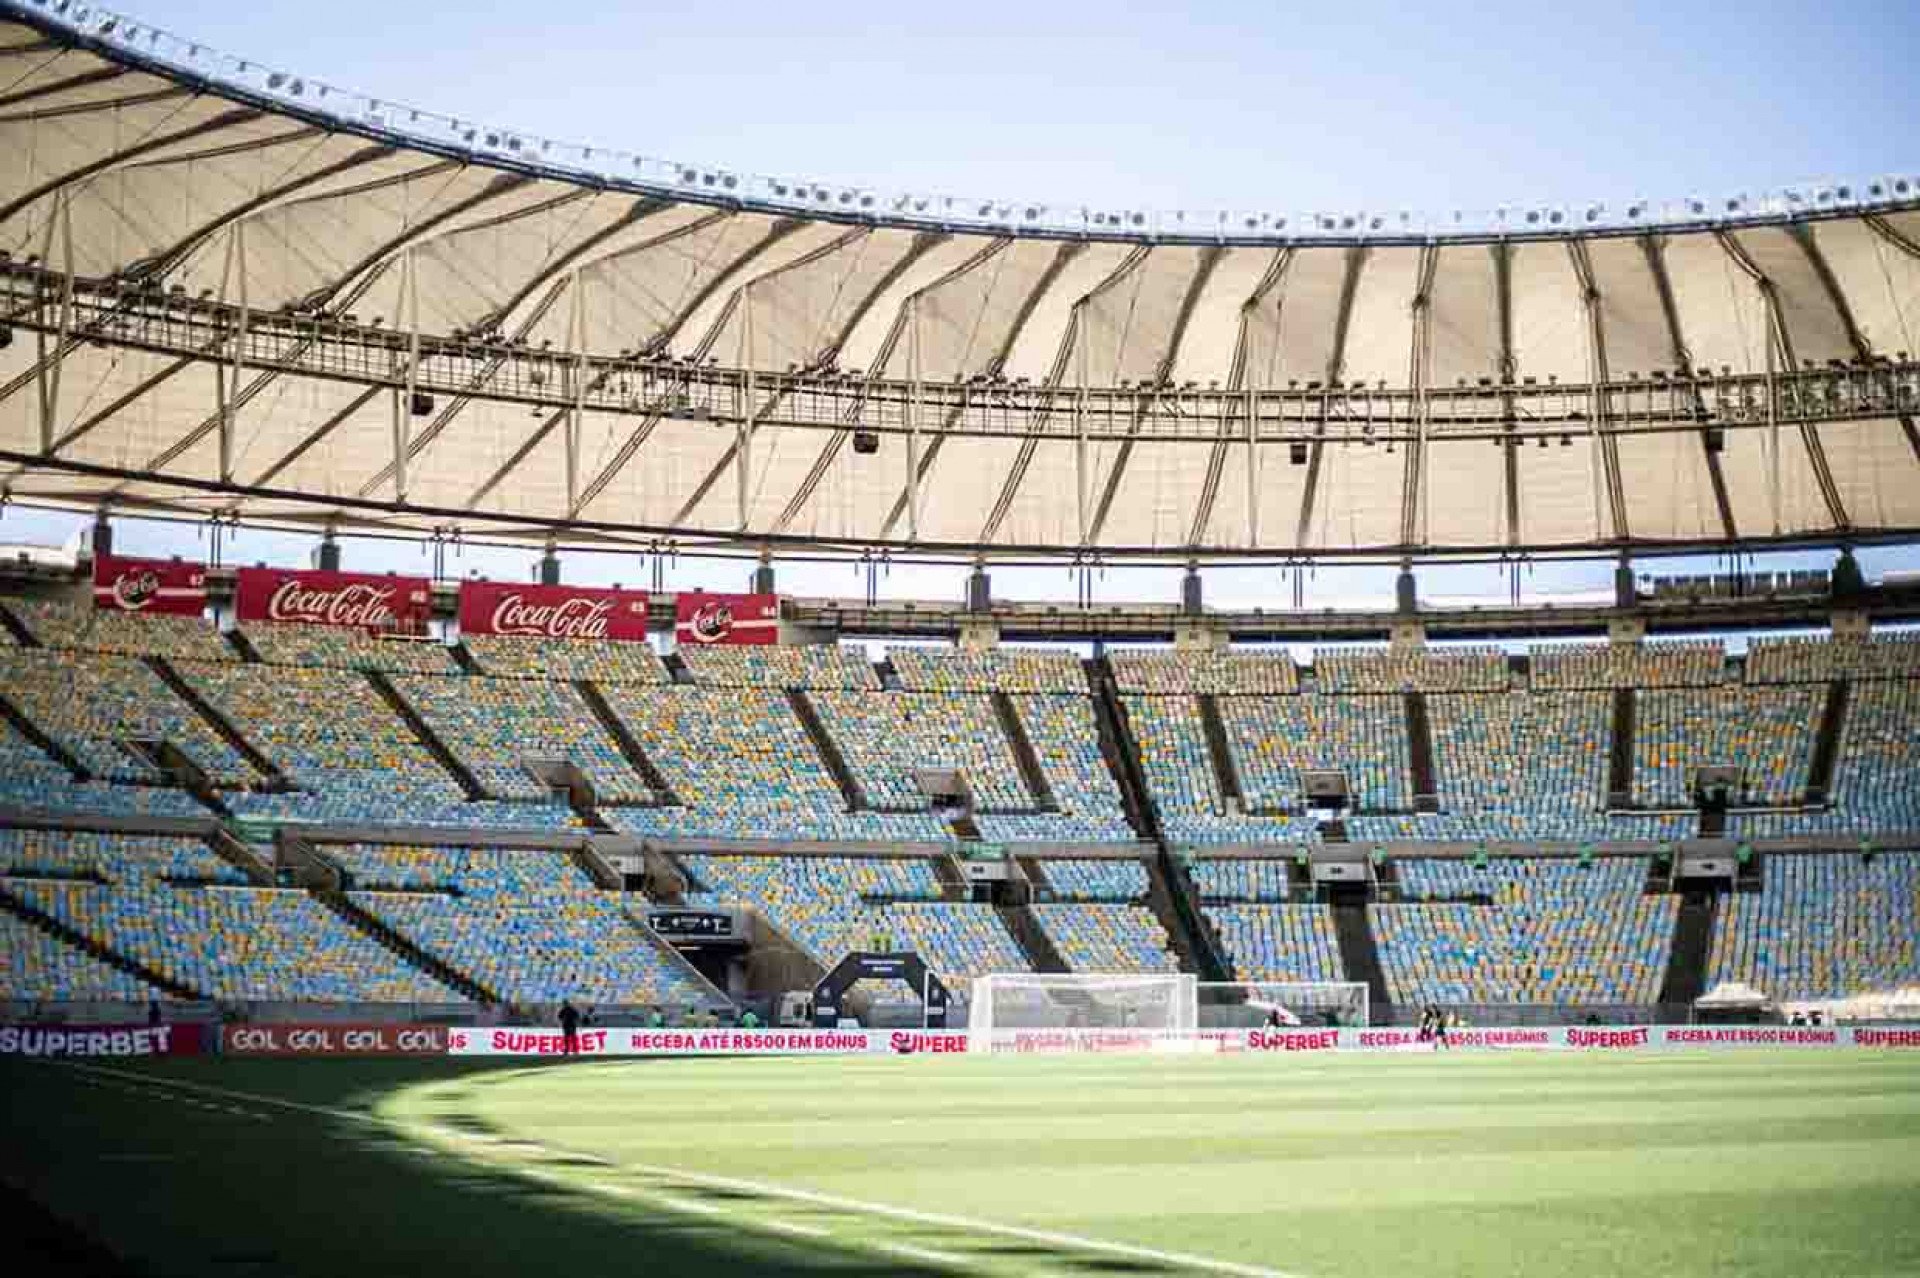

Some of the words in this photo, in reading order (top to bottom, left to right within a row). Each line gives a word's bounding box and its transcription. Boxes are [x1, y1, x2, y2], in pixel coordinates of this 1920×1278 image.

[492, 594, 615, 637] Coca-Cola
[0, 1026, 171, 1055] SUPERBET
[232, 1030, 280, 1050] GOL
[288, 1030, 334, 1050] GOL
[344, 1030, 390, 1050] GOL
[398, 1030, 443, 1050] GOL
[632, 1034, 695, 1048] RECEBA
[700, 1031, 730, 1048] ATÉ
[788, 1034, 811, 1048] EM
[815, 1031, 868, 1048] BÔNUS
[1249, 1031, 1339, 1050] SUPERBET
[1567, 1029, 1648, 1047] SUPERBET
